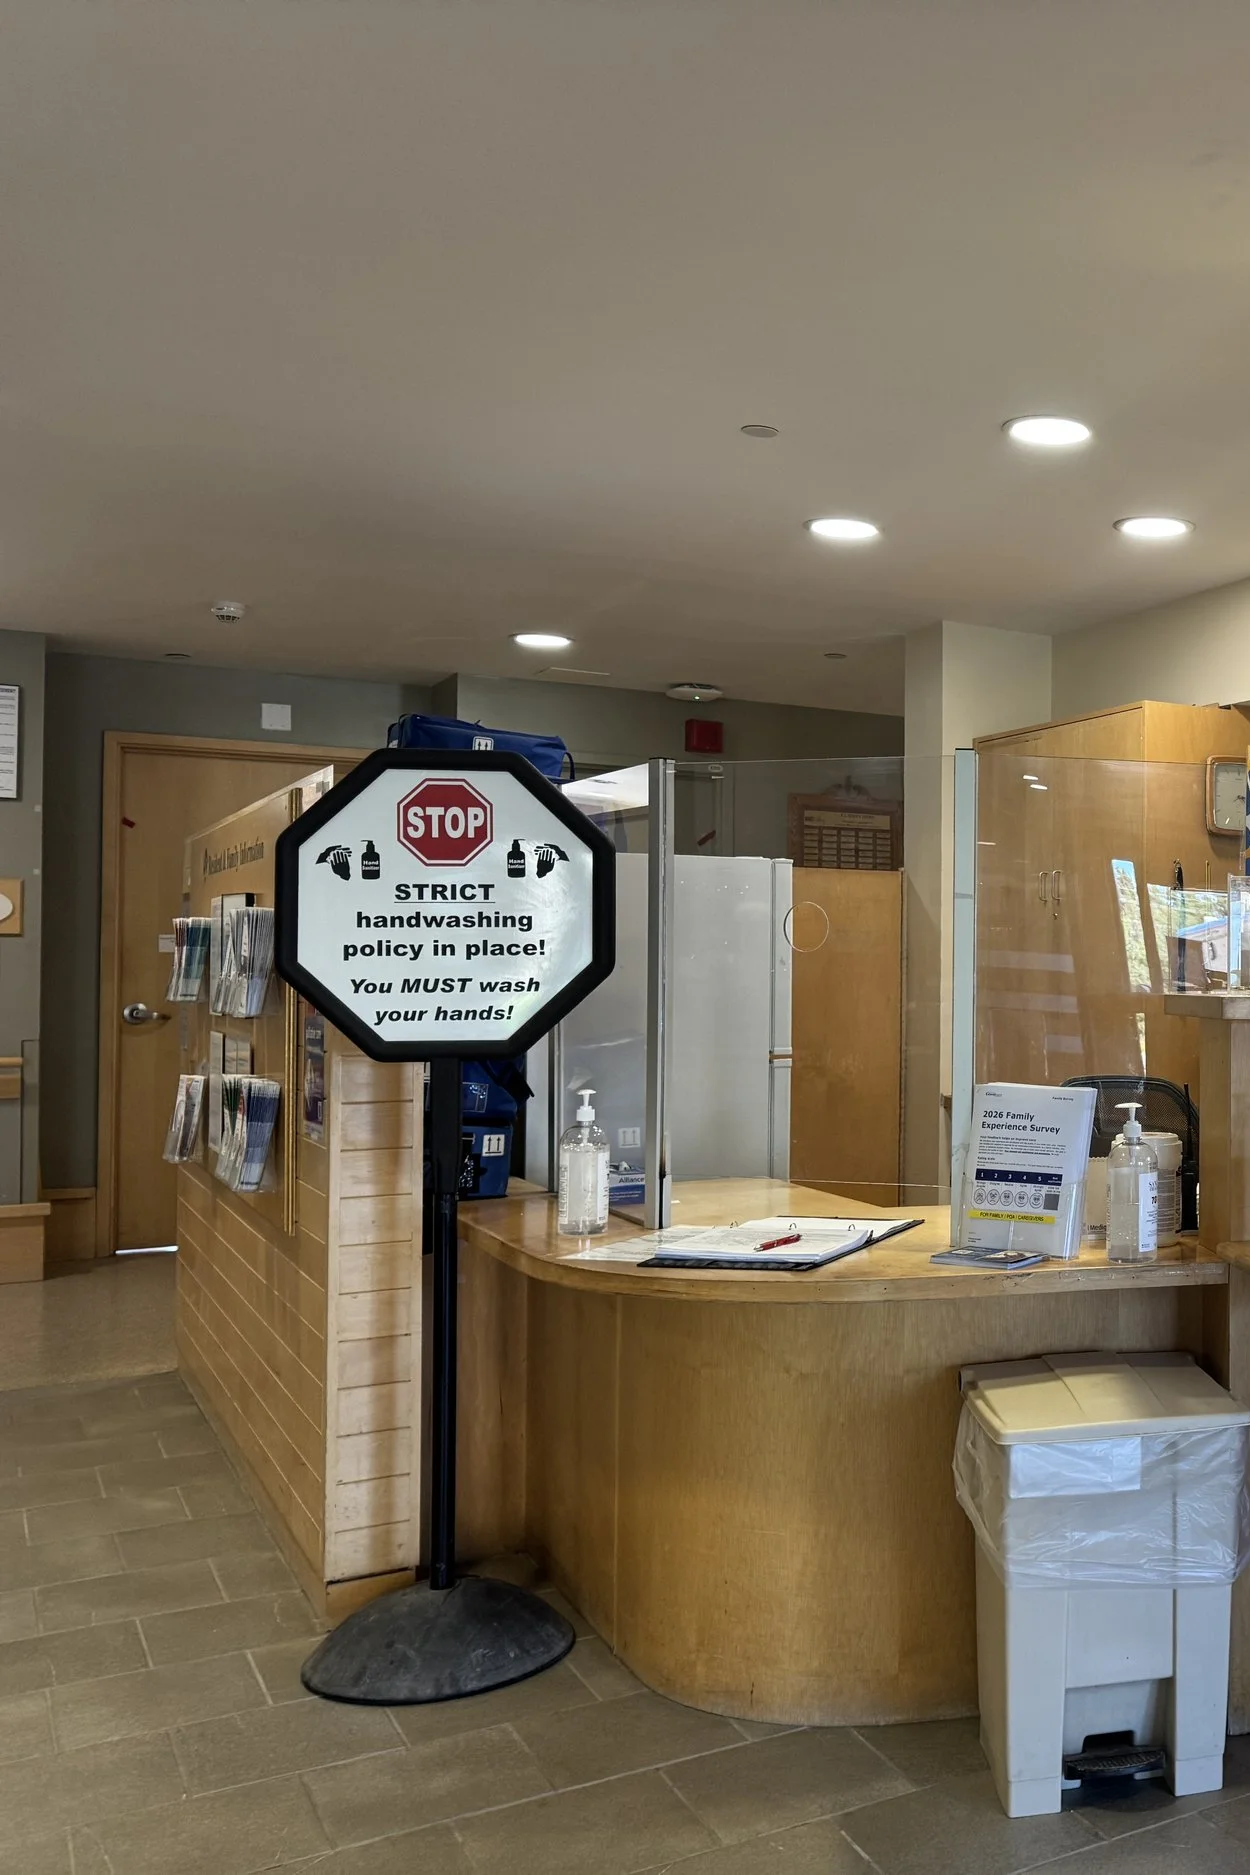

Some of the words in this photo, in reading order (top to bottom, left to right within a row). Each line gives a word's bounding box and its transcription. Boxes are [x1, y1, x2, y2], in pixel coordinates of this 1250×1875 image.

[407, 806, 485, 839] STOP
[394, 883, 495, 902] STRICT
[356, 911, 533, 932] handwashing
[343, 940, 424, 961] policy
[433, 940, 456, 956] in
[465, 939, 546, 960] place!
[350, 978, 392, 994] You
[401, 978, 473, 993] MUST
[479, 977, 541, 992] wash
[374, 1008, 428, 1026] your
[434, 1005, 514, 1021] hands!
[983, 1110, 1004, 1119] 2026
[1005, 1111, 1035, 1122] Family
[981, 1121, 1028, 1131] Experience
[1030, 1124, 1061, 1135] Survey
[1018, 1214, 1044, 1222] CAREGIVERS
